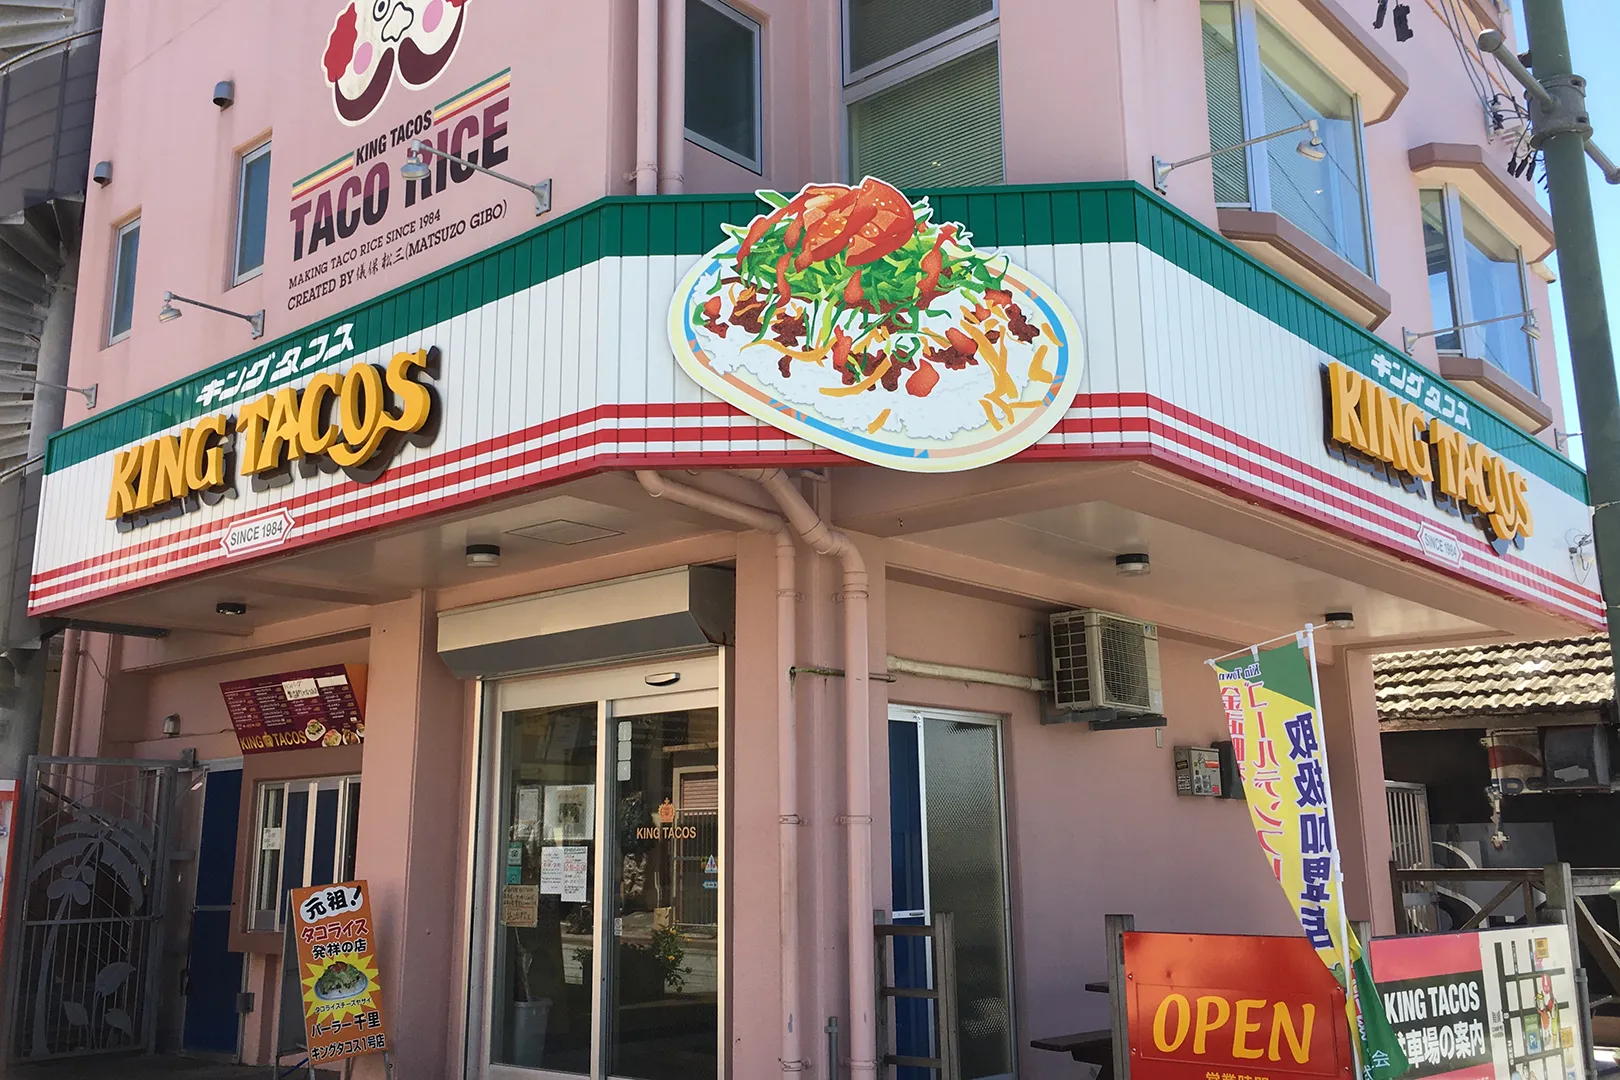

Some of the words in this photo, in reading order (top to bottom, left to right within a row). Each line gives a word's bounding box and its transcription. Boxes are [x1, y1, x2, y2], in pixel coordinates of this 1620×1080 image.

[356, 137, 387, 166] KING
[390, 109, 432, 148] TACOS
[290, 161, 390, 261] TACO
[405, 97, 510, 208] RICE
[287, 278, 337, 311] CREATED
[340, 269, 355, 289] BY
[470, 198, 508, 230] GIBO)
[289, 261, 328, 289] MAKING
[331, 248, 358, 270] TACO
[360, 236, 384, 257] RICE
[386, 220, 416, 245] SINCE
[419, 208, 441, 230] 1984
[105, 412, 227, 521] KING
[236, 347, 432, 476] TACOS
[1328, 361, 1434, 482] KING
[1429, 417, 1535, 541] TACOS
[230, 526, 260, 547] SINCE
[262, 519, 283, 538] 1984
[240, 735, 264, 751] KING
[273, 730, 308, 747] TACOS
[636, 827, 661, 840] KING
[662, 826, 697, 840] TACOS
[301, 918, 369, 943] タコライス
[312, 939, 367, 960] 発祥の店
[1152, 993, 1316, 1065] OPEN
[1383, 988, 1428, 1024] KING
[1427, 981, 1480, 1018] TACOS
